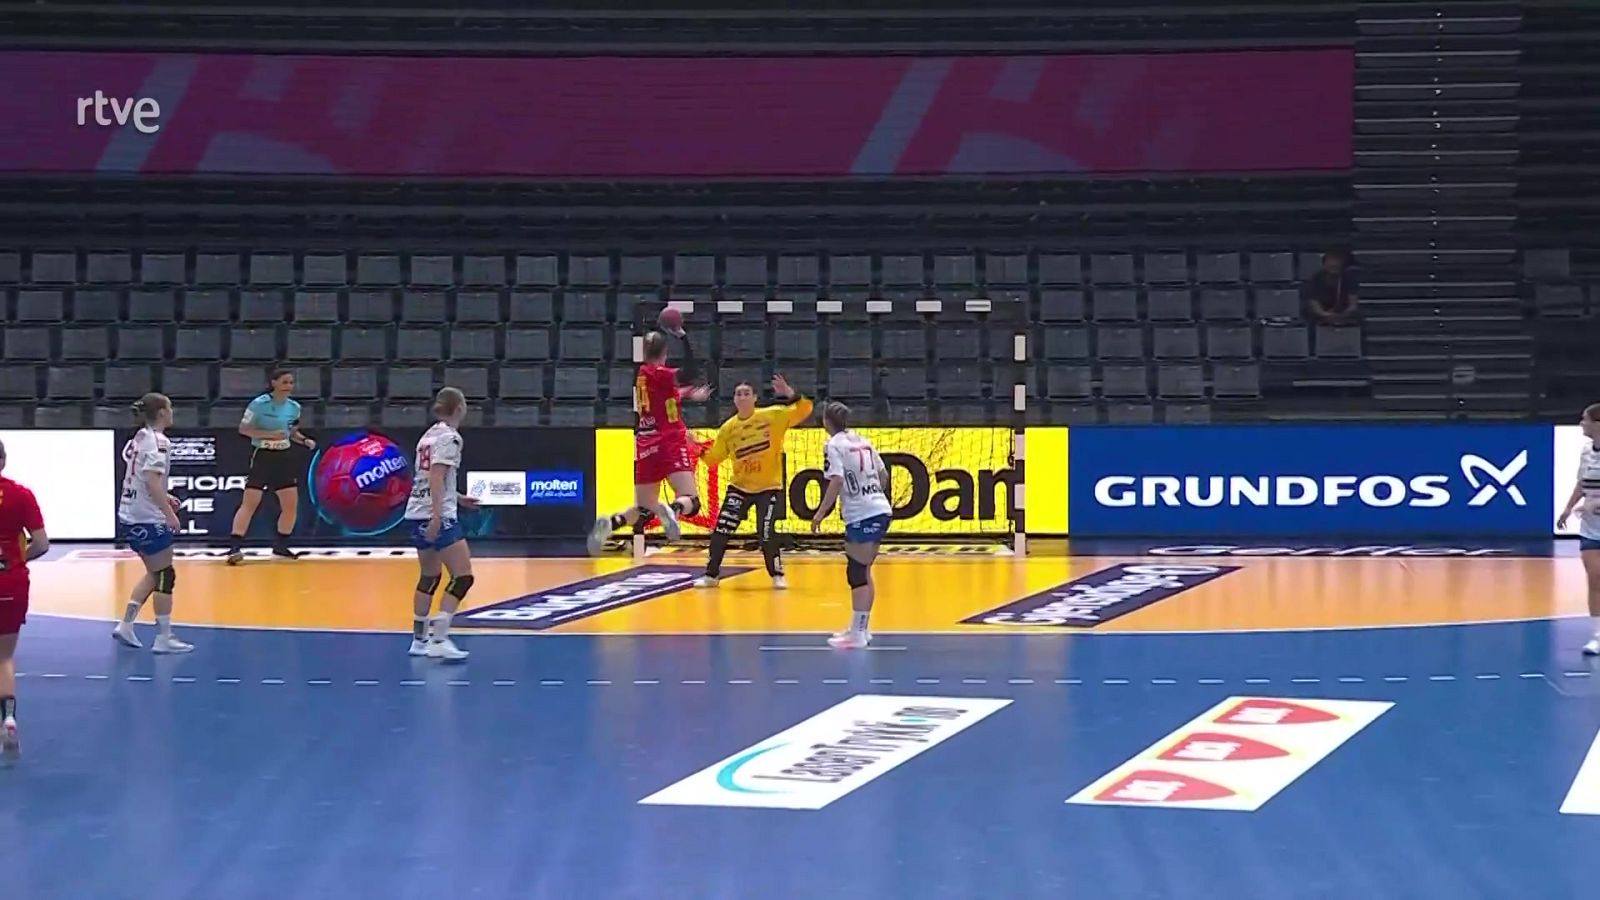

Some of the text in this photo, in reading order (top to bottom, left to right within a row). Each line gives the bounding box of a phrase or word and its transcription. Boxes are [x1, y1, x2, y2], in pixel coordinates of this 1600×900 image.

[356, 456, 408, 489] molten
[530, 479, 578, 491] molten
[1094, 475, 1451, 508] GRUNDFOS
